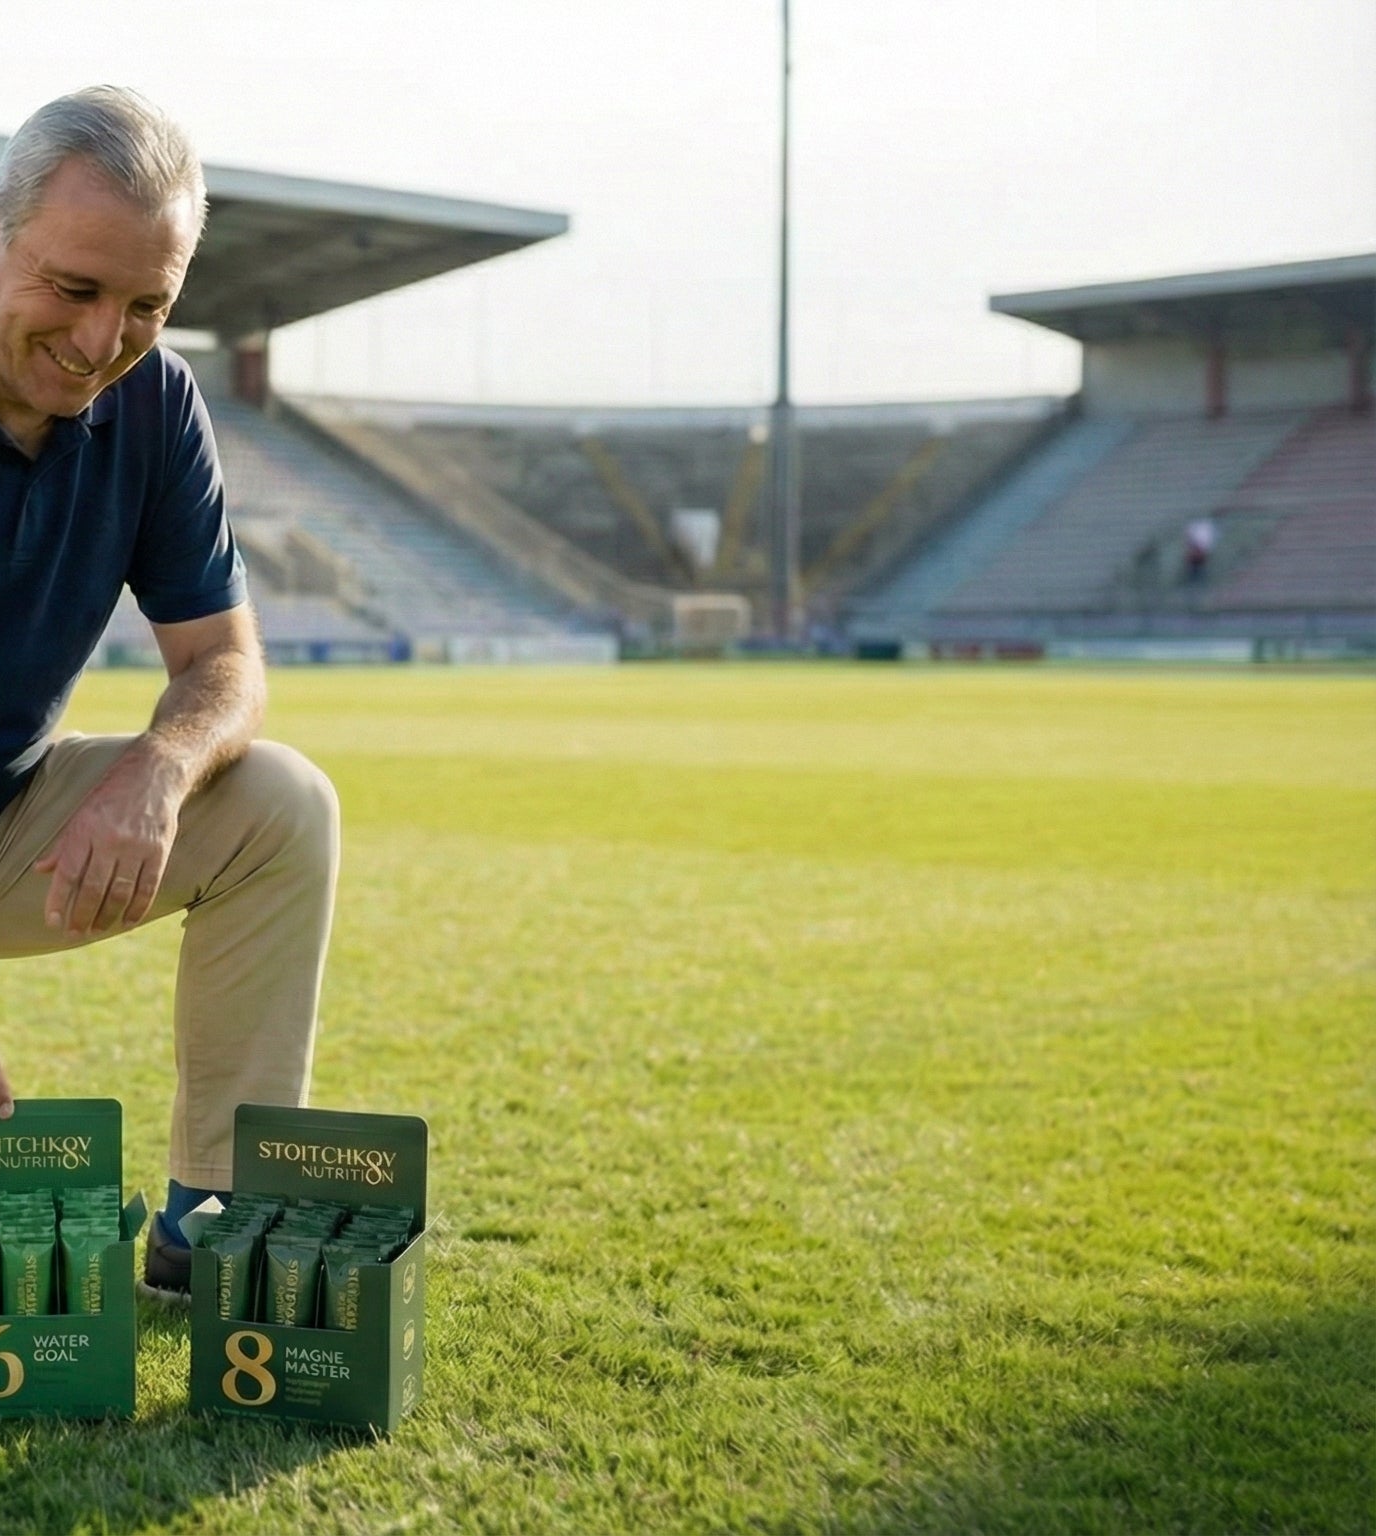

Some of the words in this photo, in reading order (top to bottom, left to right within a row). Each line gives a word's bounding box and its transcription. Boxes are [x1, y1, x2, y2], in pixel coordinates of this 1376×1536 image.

[258, 1140, 398, 1169] STOITCHKOV
[301, 1163, 395, 1185] NUTRITION
[32, 1334, 90, 1348] WATER
[32, 1349, 78, 1362] GOAL
[285, 1346, 344, 1364] MAGNE
[221, 1330, 277, 1406] 8
[285, 1360, 351, 1380] MASTER
